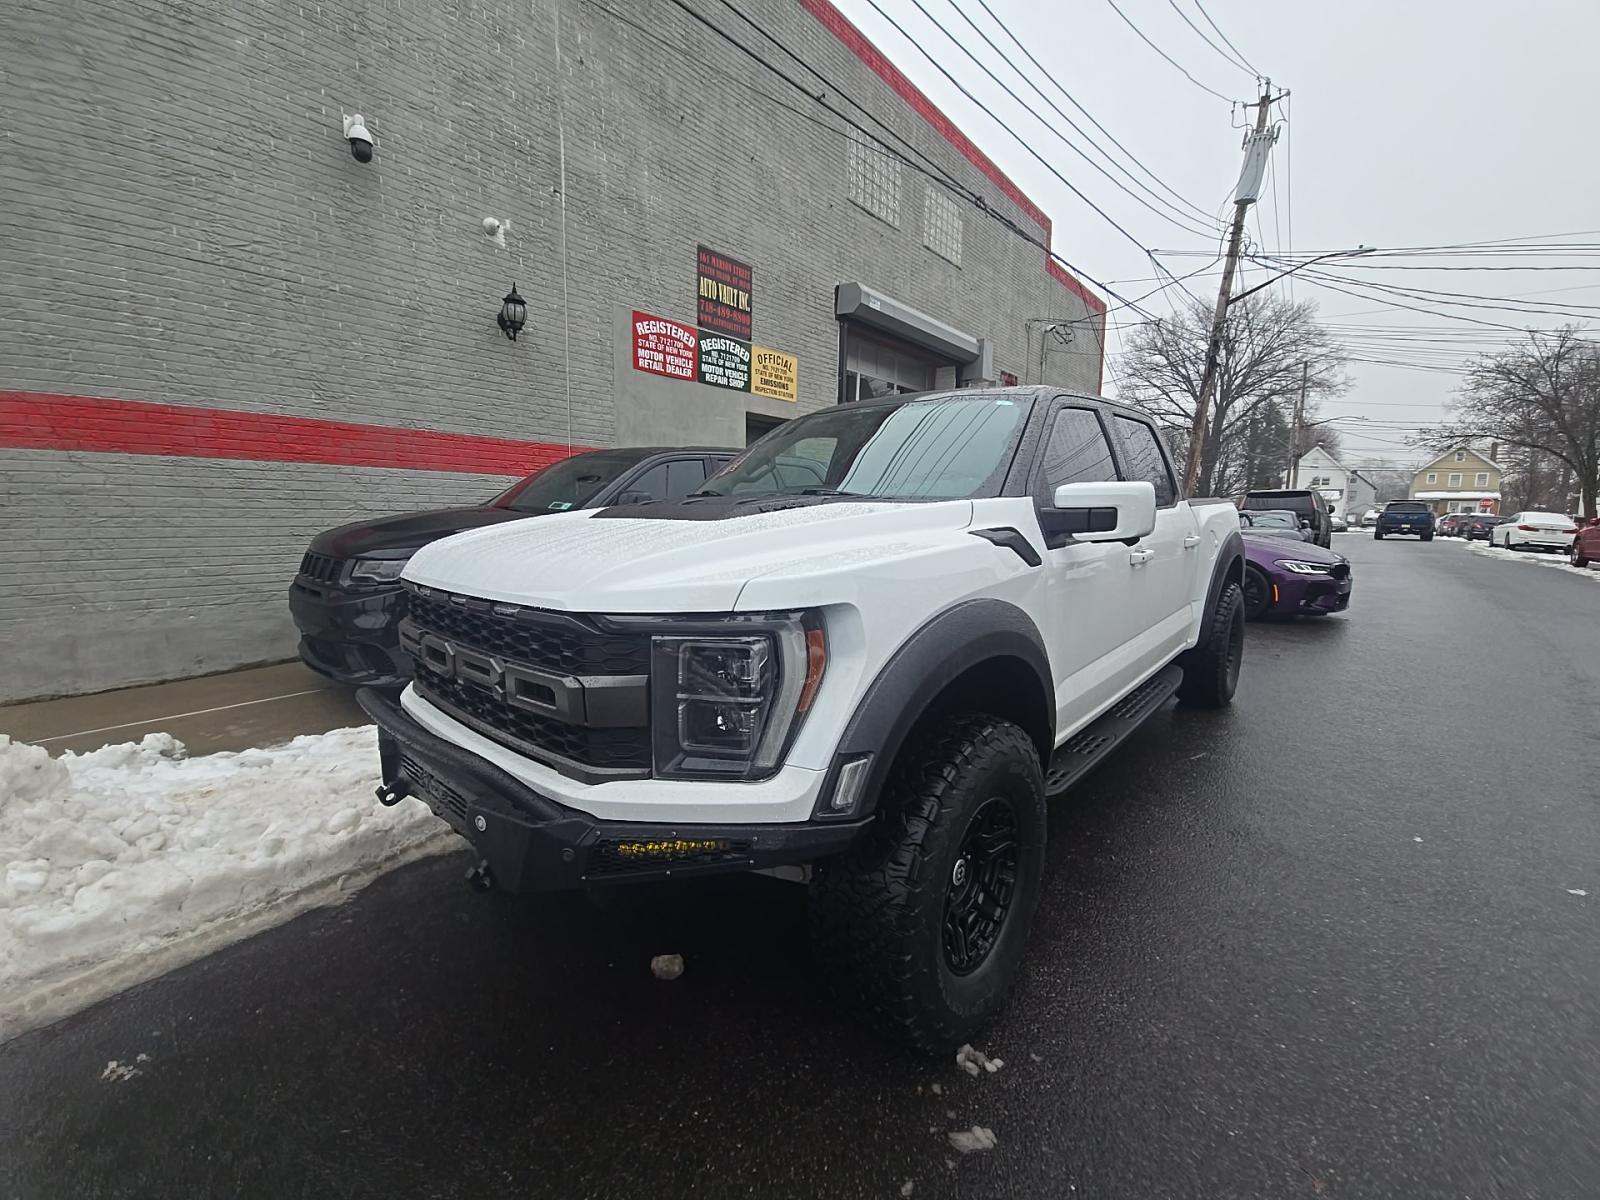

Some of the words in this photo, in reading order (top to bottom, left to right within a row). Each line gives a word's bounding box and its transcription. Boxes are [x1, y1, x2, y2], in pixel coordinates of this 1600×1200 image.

[700, 276, 717, 300] AUTO
[718, 283, 737, 307] VAULT
[739, 290, 751, 312] INC.
[636, 320, 695, 347] REGISTERED
[648, 334, 658, 342] NO.
[638, 339, 656, 349] STATE
[657, 343, 664, 351] OF
[666, 346, 678, 354] NEW
[679, 349, 693, 358] YORK
[700, 338, 749, 362] REGISTERED
[638, 348, 664, 362] MOTOR
[666, 354, 693, 368] VEHICLE
[702, 355, 717, 364] STATE
[757, 354, 792, 372] OFFICIAL
[639, 358, 664, 371] RETAIL
[666, 364, 692, 378] DEALER
[702, 363, 723, 376] MOTOR
[725, 368, 748, 381] VEHICLE
[755, 369, 767, 377] STATE
[706, 373, 728, 385] REPAIR
[729, 378, 744, 388] SHOP
[760, 377, 789, 390] EMISSIONS
[755, 386, 777, 395] INSPECTION
[778, 390, 794, 399] STATION
